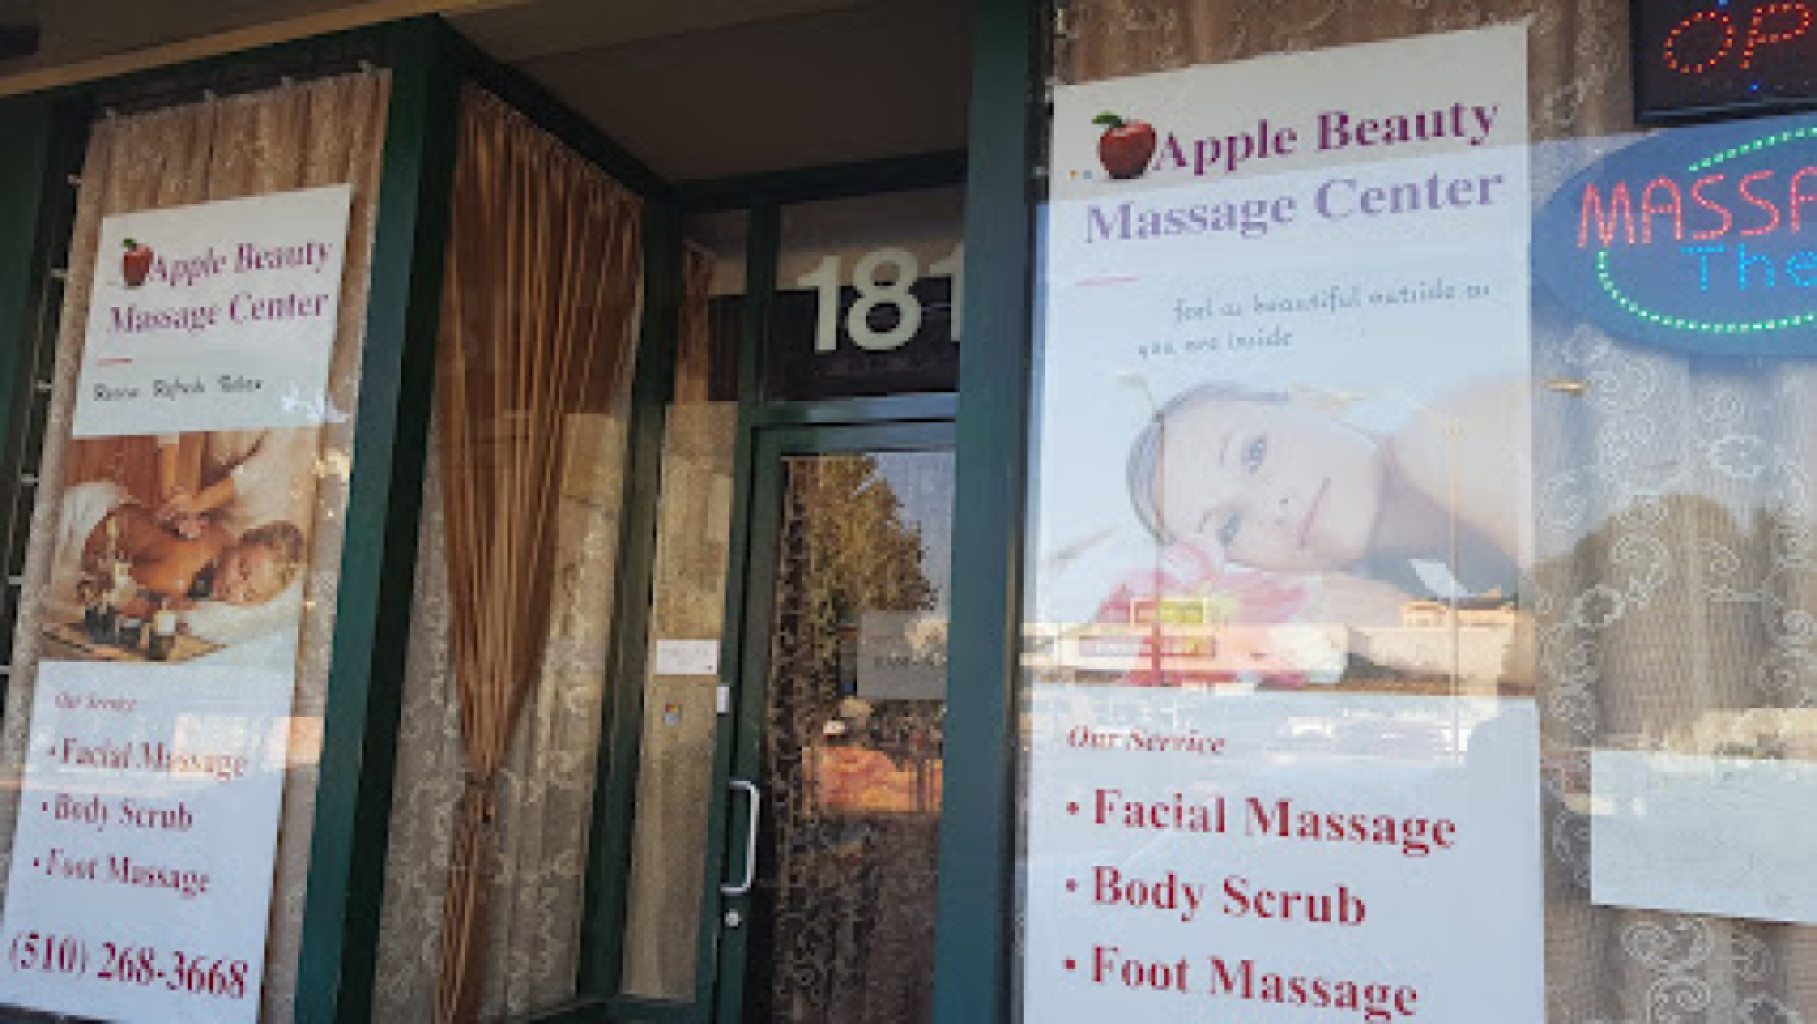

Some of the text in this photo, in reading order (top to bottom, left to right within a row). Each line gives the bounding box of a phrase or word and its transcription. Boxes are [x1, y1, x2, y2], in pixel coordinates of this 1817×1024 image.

[1664, 1, 1813, 73] OP
[1152, 101, 1499, 177] Apple Beauty
[1084, 171, 1504, 244] Massage Center
[1577, 166, 1817, 248] MASSA
[149, 240, 333, 287] Apple Beauty
[1680, 243, 1817, 291] The
[107, 290, 331, 335] Massage Center
[796, 240, 965, 355] 181
[1173, 297, 1213, 324] feel
[1219, 302, 1243, 317] as
[1253, 285, 1362, 313] beautiful
[1368, 277, 1457, 305] outside
[1138, 338, 1177, 359] you
[1227, 324, 1294, 350] inside
[55, 691, 81, 710] Our
[62, 737, 249, 784] Facial Massage
[1066, 725, 1226, 756] Our Service
[55, 792, 194, 833] Body Scrub
[1093, 788, 1457, 858] Facial Massage
[46, 848, 211, 900] Foot Massage
[1092, 865, 1367, 927] Body Scrub
[8, 929, 250, 1000] (510) 268-3668
[1091, 944, 1418, 1023] Foot Massage
